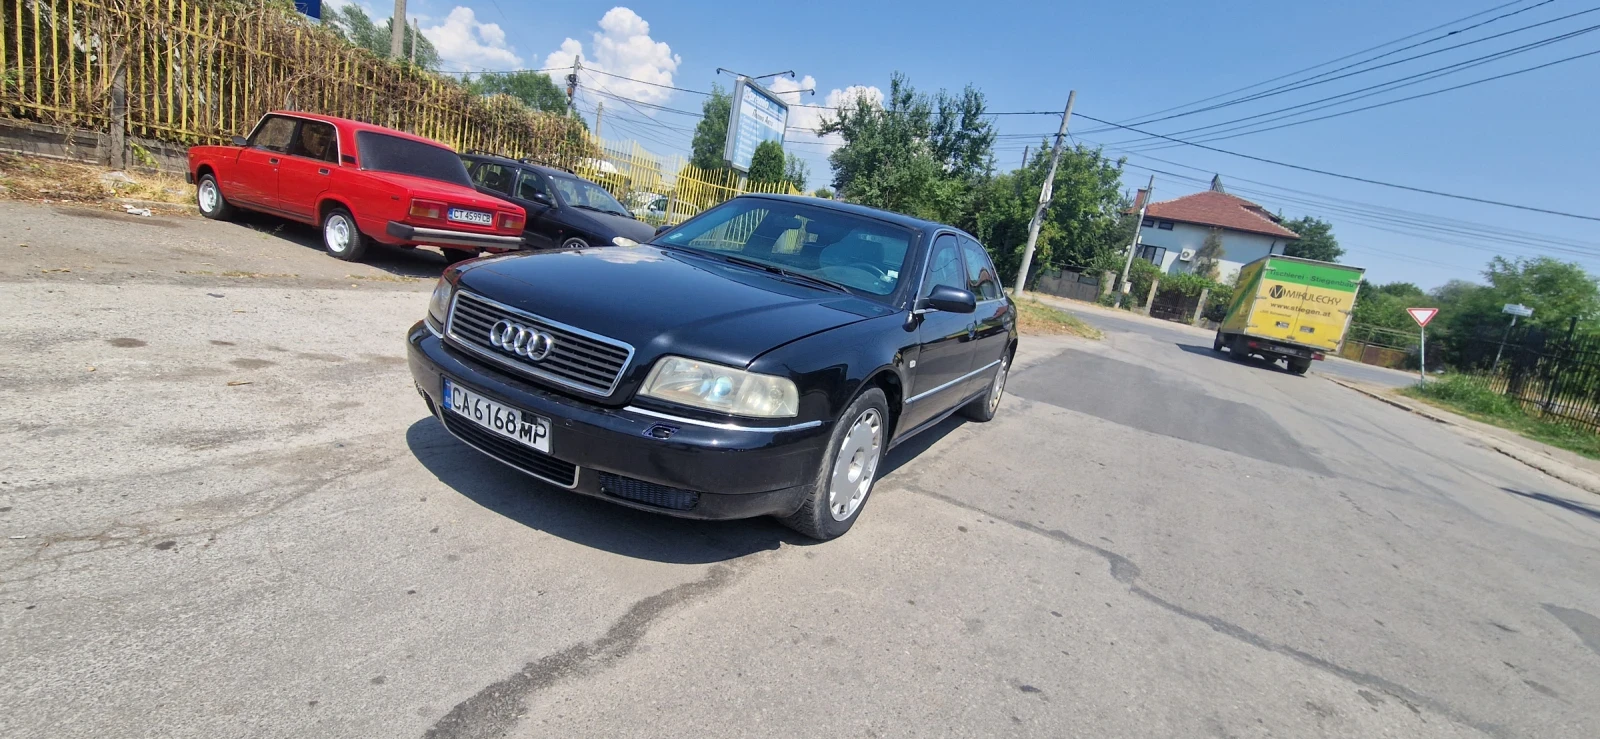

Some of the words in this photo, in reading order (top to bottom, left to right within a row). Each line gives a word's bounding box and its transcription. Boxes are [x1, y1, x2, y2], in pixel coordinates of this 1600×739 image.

[1270, 269, 1305, 280] Tischlerei
[1310, 275, 1354, 288] Stiegenbau
[1286, 289, 1342, 306] MIKULECKY
[1270, 302, 1331, 317] www.stiegen.at
[452, 387, 471, 416] CA
[474, 398, 517, 435] 6168
[519, 422, 547, 444] MP
